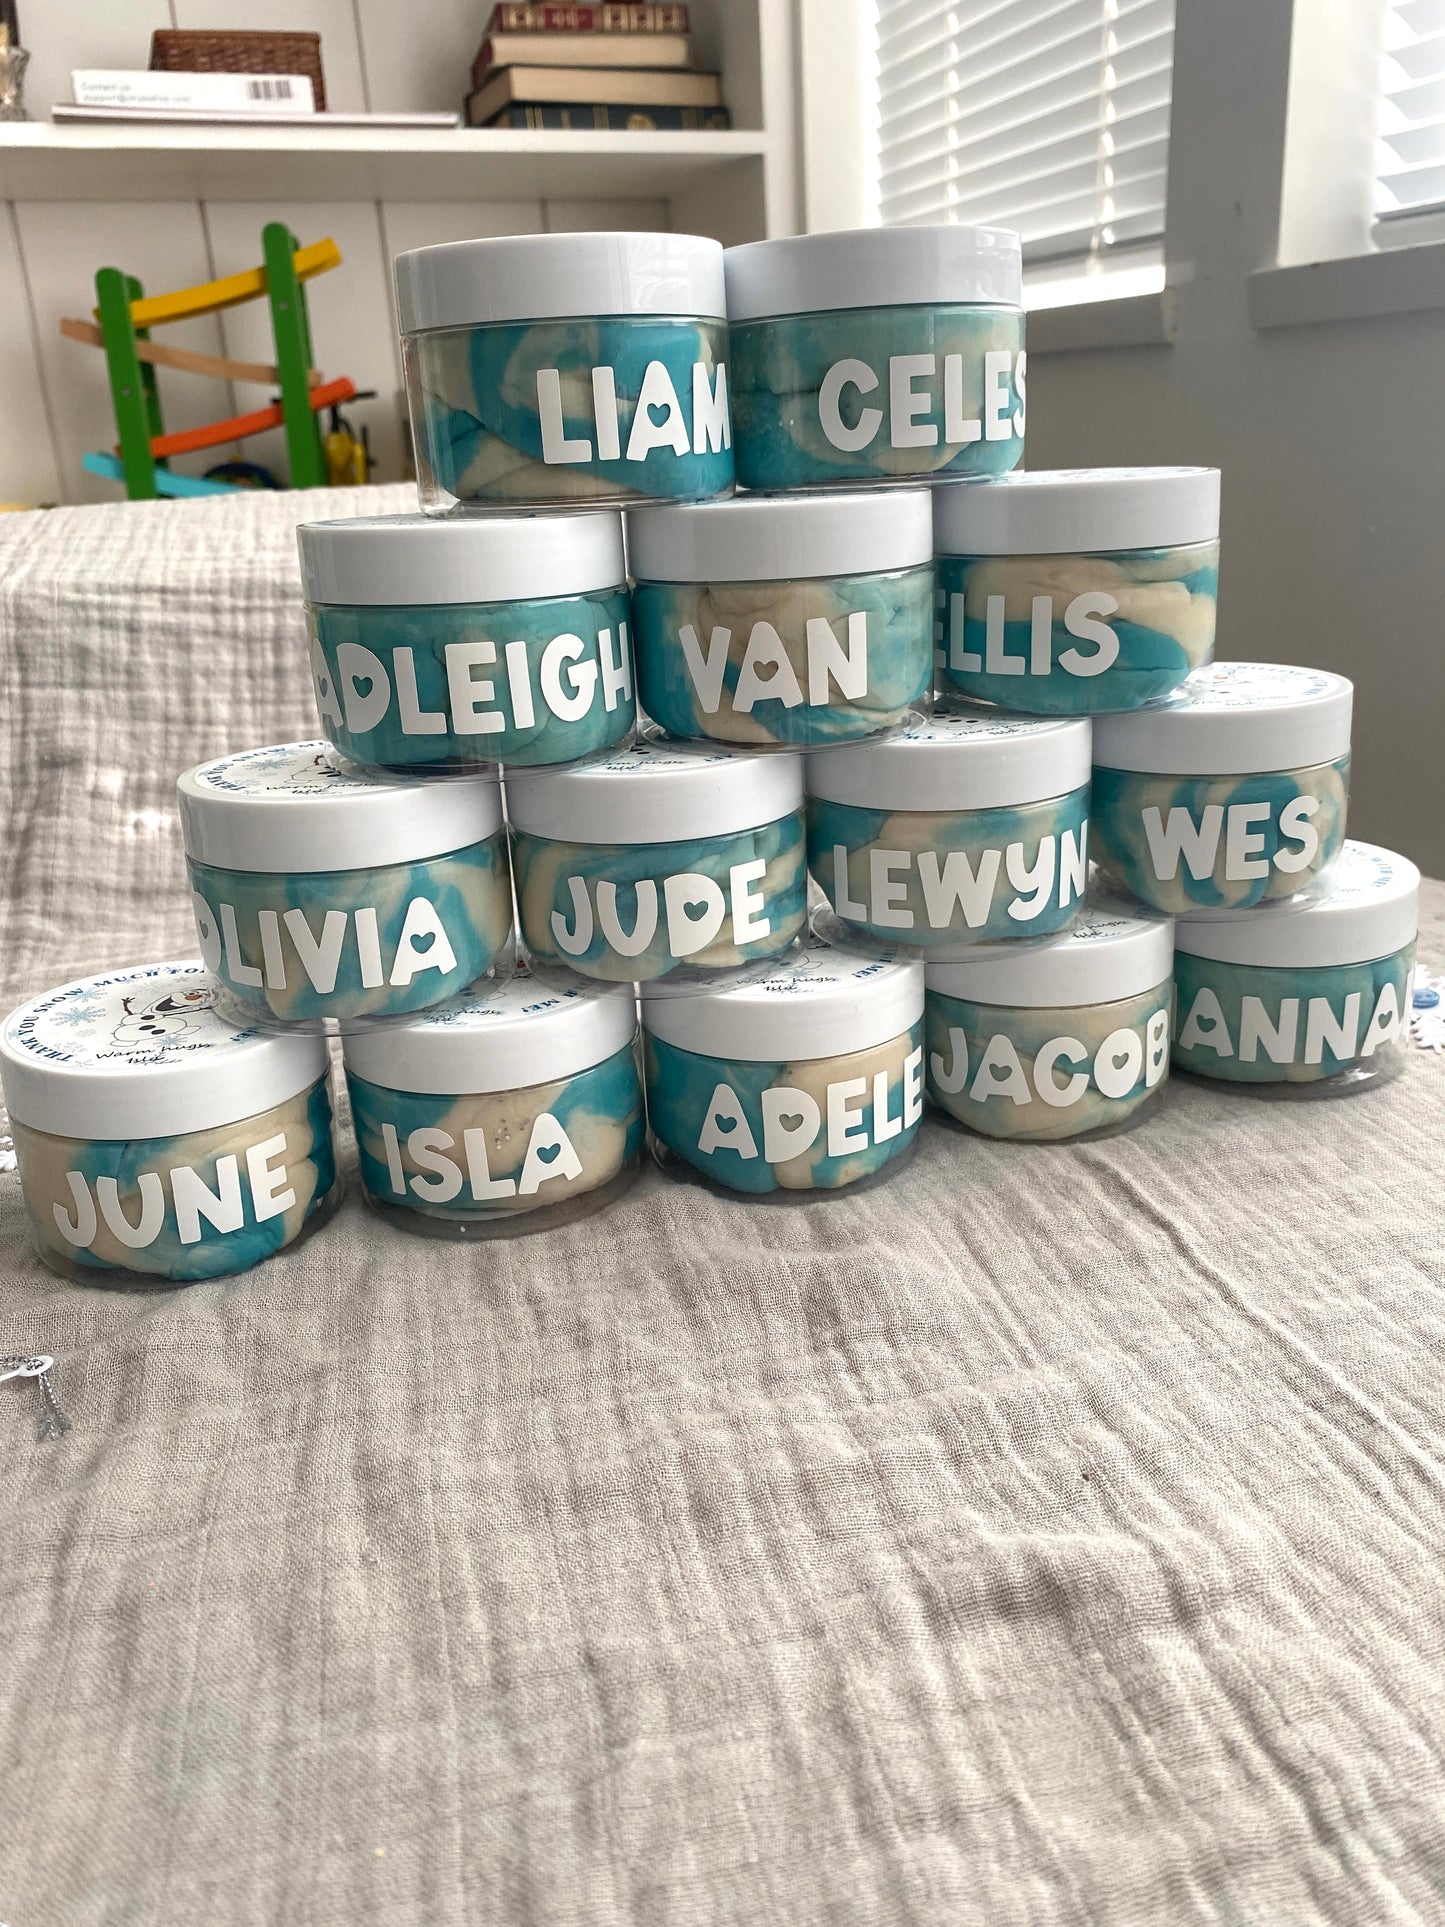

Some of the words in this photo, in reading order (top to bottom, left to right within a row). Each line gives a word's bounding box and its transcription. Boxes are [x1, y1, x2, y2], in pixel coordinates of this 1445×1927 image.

[536, 360, 731, 464] LIAM
[678, 611, 868, 714] VAN
[834, 819, 1088, 929] LEWYN
[1141, 795, 1319, 881] WES
[193, 891, 458, 994] OLIVIA
[551, 858, 771, 957] JUDE
[33, 987, 84, 1014] SNOW
[93, 969, 160, 988] MUCH
[169, 967, 205, 976] FO
[521, 998, 561, 1013] ME!
[1171, 971, 1414, 1064] ANNA
[18, 1015, 40, 1035] YOU
[21, 1036, 77, 1063] THANK
[96, 1049, 155, 1060] Warm
[930, 1008, 1169, 1107] JACOB
[698, 1045, 922, 1163] ADELE
[52, 1132, 296, 1249] JUNE
[381, 1112, 584, 1203] ISLA
